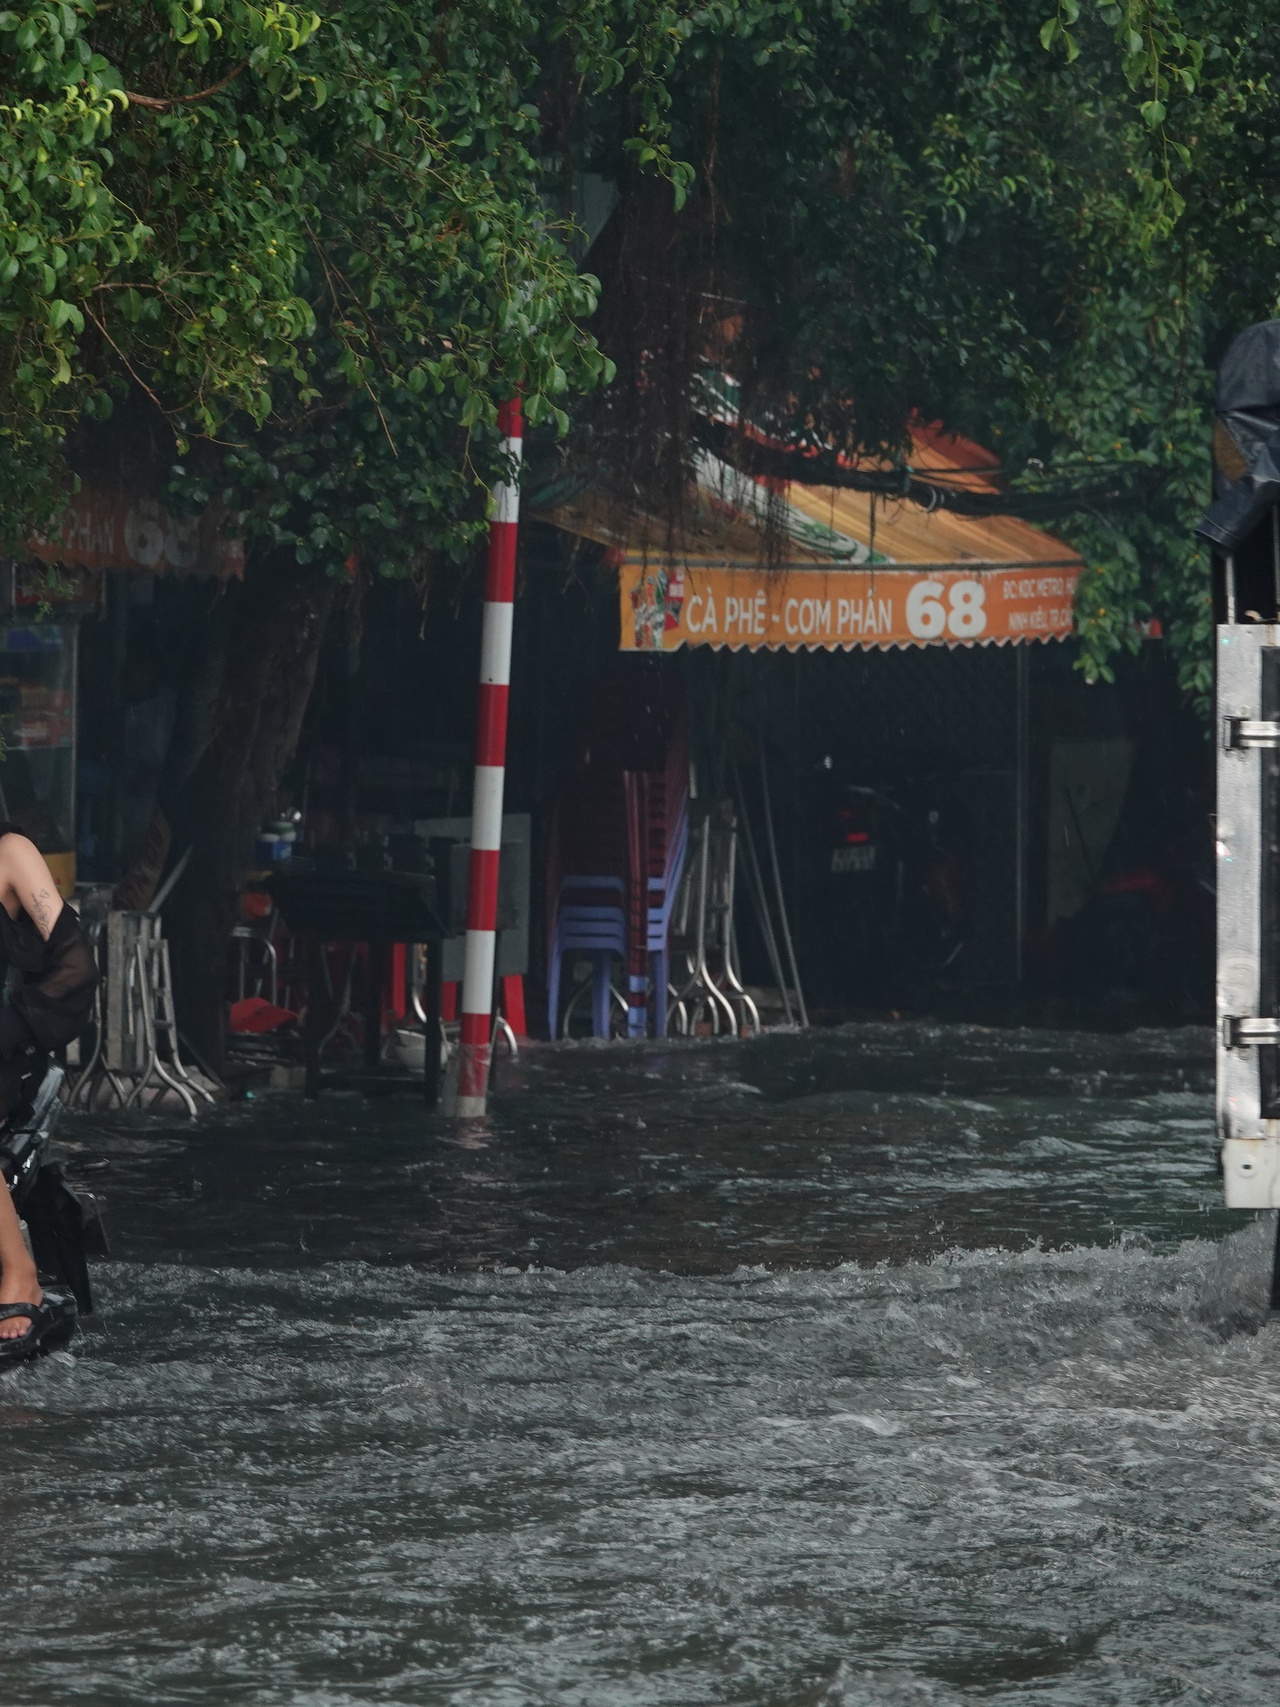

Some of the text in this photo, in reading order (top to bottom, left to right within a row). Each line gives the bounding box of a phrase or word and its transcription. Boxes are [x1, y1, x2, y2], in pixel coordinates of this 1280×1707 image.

[686, 587, 718, 634] CÀ
[724, 588, 767, 634] PHÊ
[906, 580, 987, 640] 68
